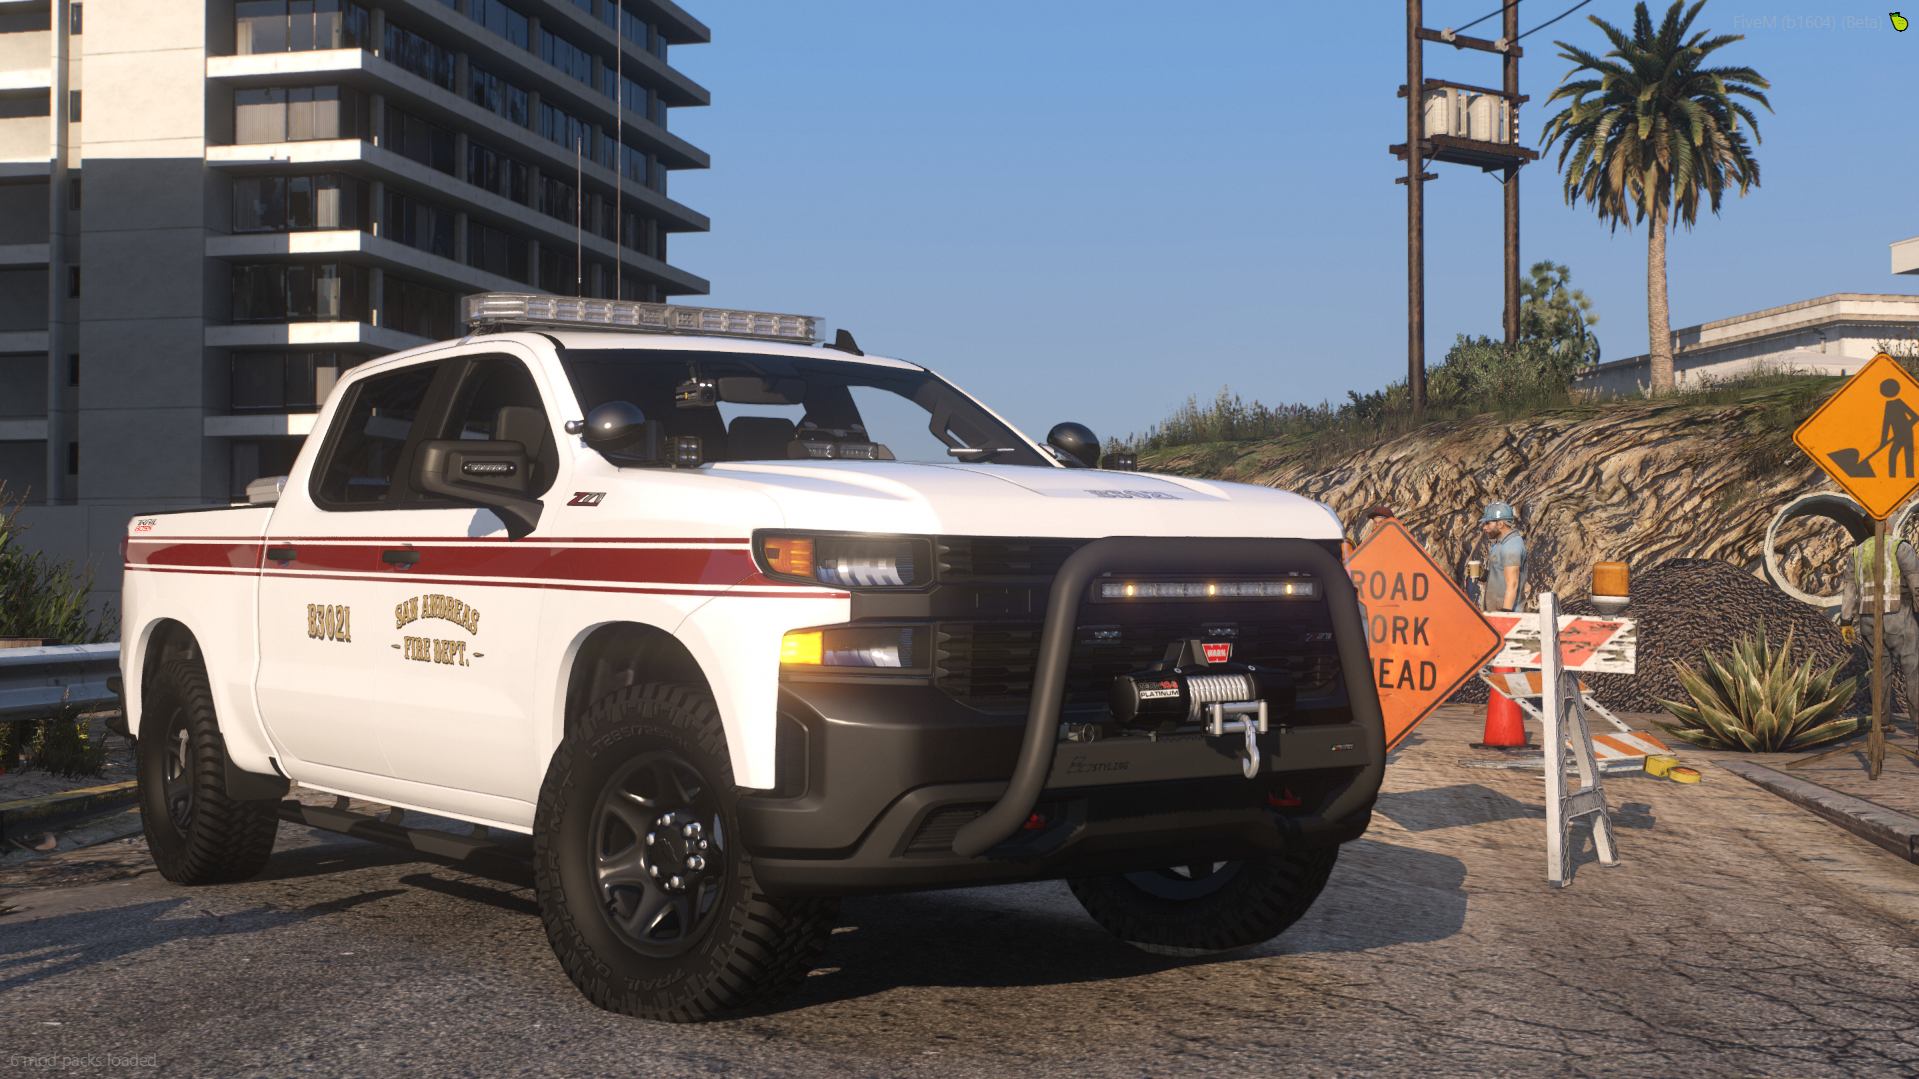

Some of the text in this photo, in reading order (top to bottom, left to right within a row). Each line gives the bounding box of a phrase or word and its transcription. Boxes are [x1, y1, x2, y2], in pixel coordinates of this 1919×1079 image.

[1351, 570, 1429, 602] ROAD
[394, 593, 480, 636] SAN ANDREAS
[1370, 614, 1430, 647] ORK
[403, 635, 470, 668] FIRE DEPT.
[1206, 648, 1226, 658] WARN
[1371, 657, 1437, 691] EAD
[1140, 690, 1179, 699] PLATINUM
[548, 848, 614, 980] GRAPPLER
[623, 967, 687, 992] TRAIL
